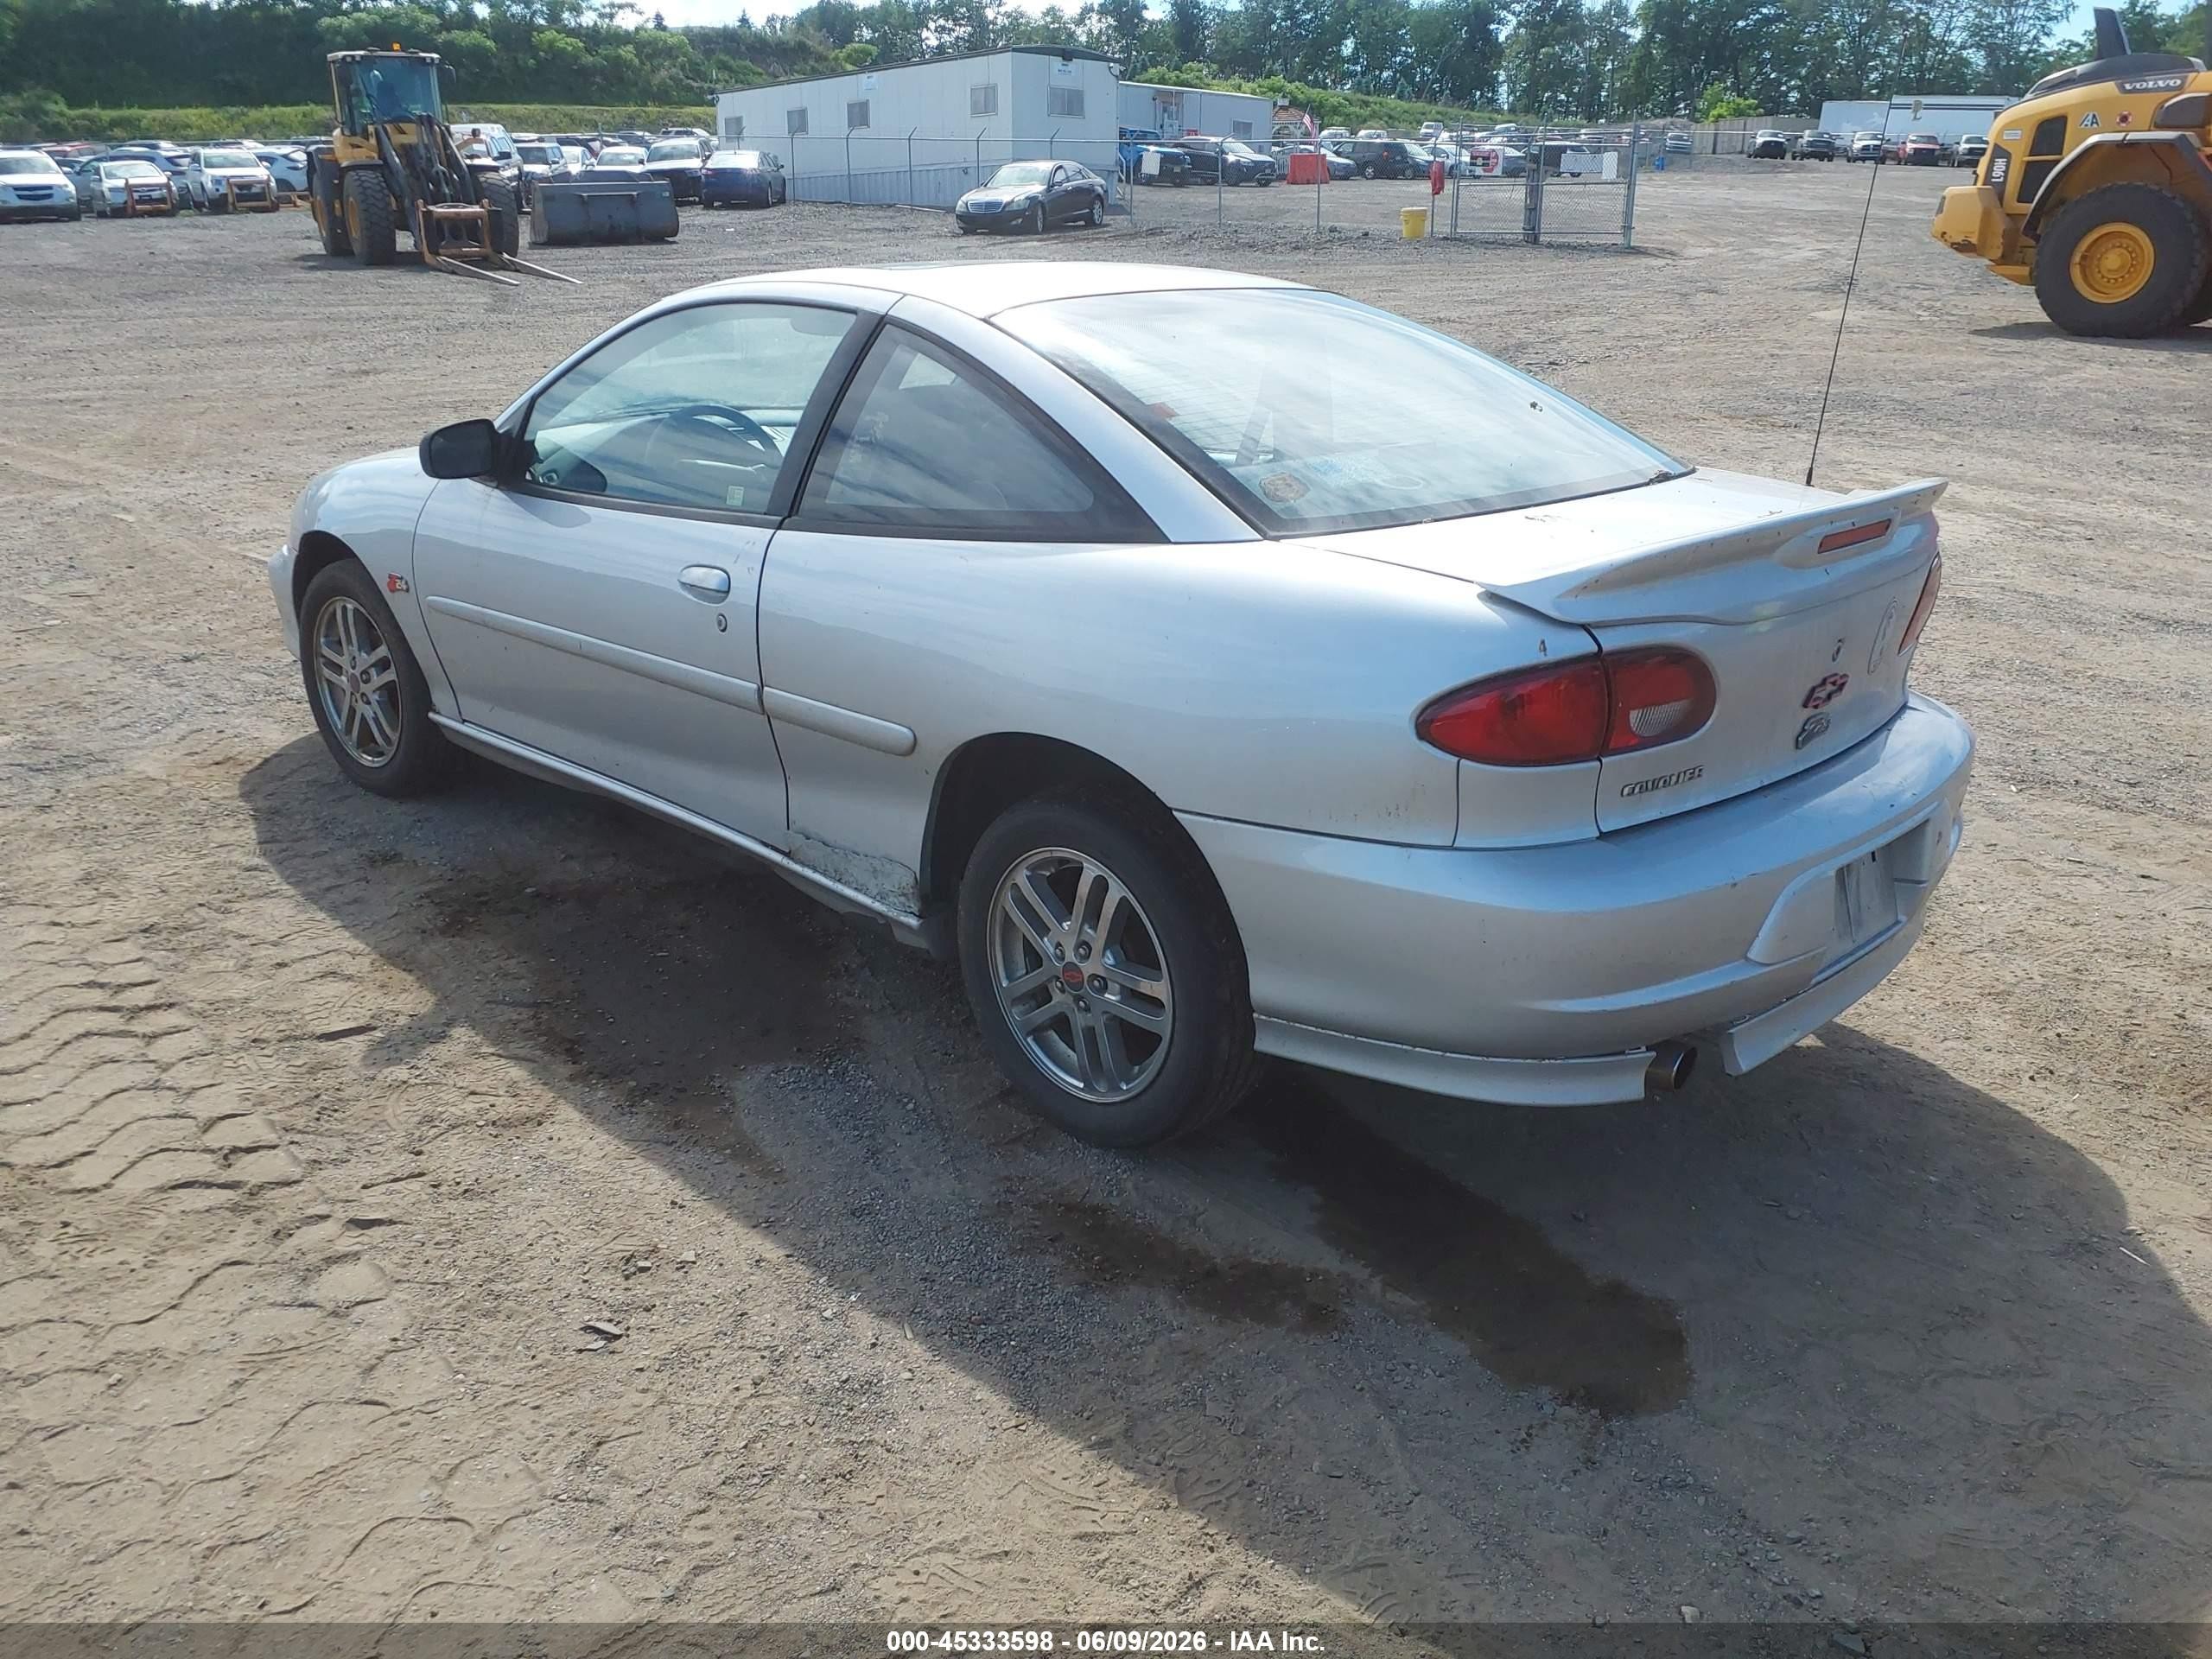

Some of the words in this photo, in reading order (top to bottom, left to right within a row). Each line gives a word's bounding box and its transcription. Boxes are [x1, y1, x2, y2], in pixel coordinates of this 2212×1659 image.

[2123, 79, 2182, 90] VOLVO
[1991, 158, 2008, 182] L90H
[1620, 765, 1705, 798] CAVALIER
